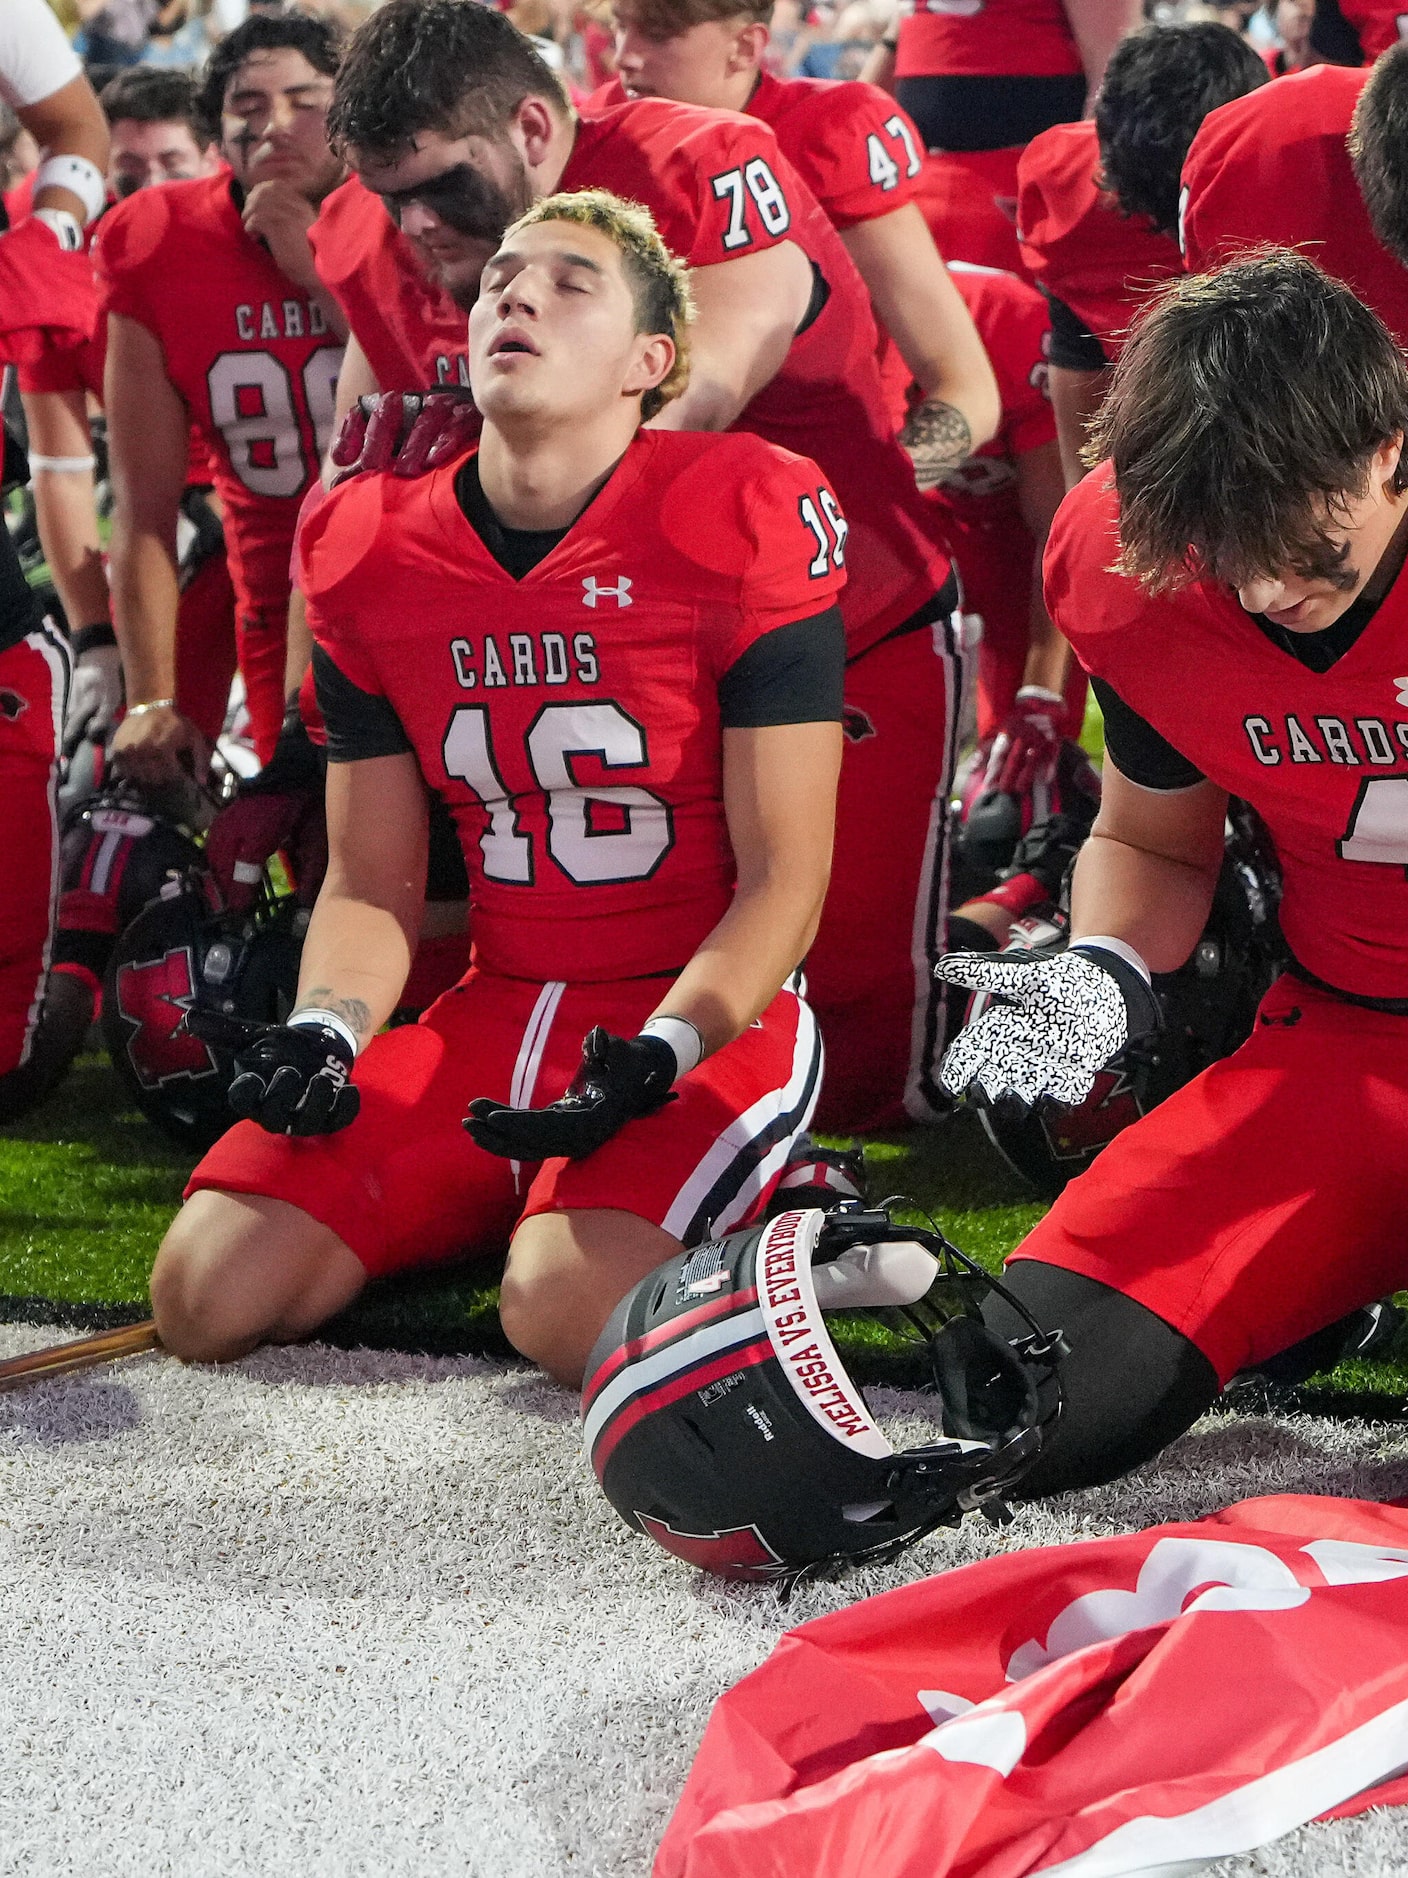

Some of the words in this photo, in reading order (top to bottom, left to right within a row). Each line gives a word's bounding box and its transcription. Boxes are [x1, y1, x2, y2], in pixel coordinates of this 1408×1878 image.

[866, 115, 922, 192] 47
[710, 154, 792, 251] 78
[797, 486, 848, 580] 16
[450, 632, 602, 690] CARDS
[442, 699, 677, 887] 16
[764, 1209, 807, 1309] EVERYBODY
[774, 1304, 812, 1346] VS.
[746, 1404, 775, 1442] Riddell
[789, 1343, 870, 1438] MELISSA
